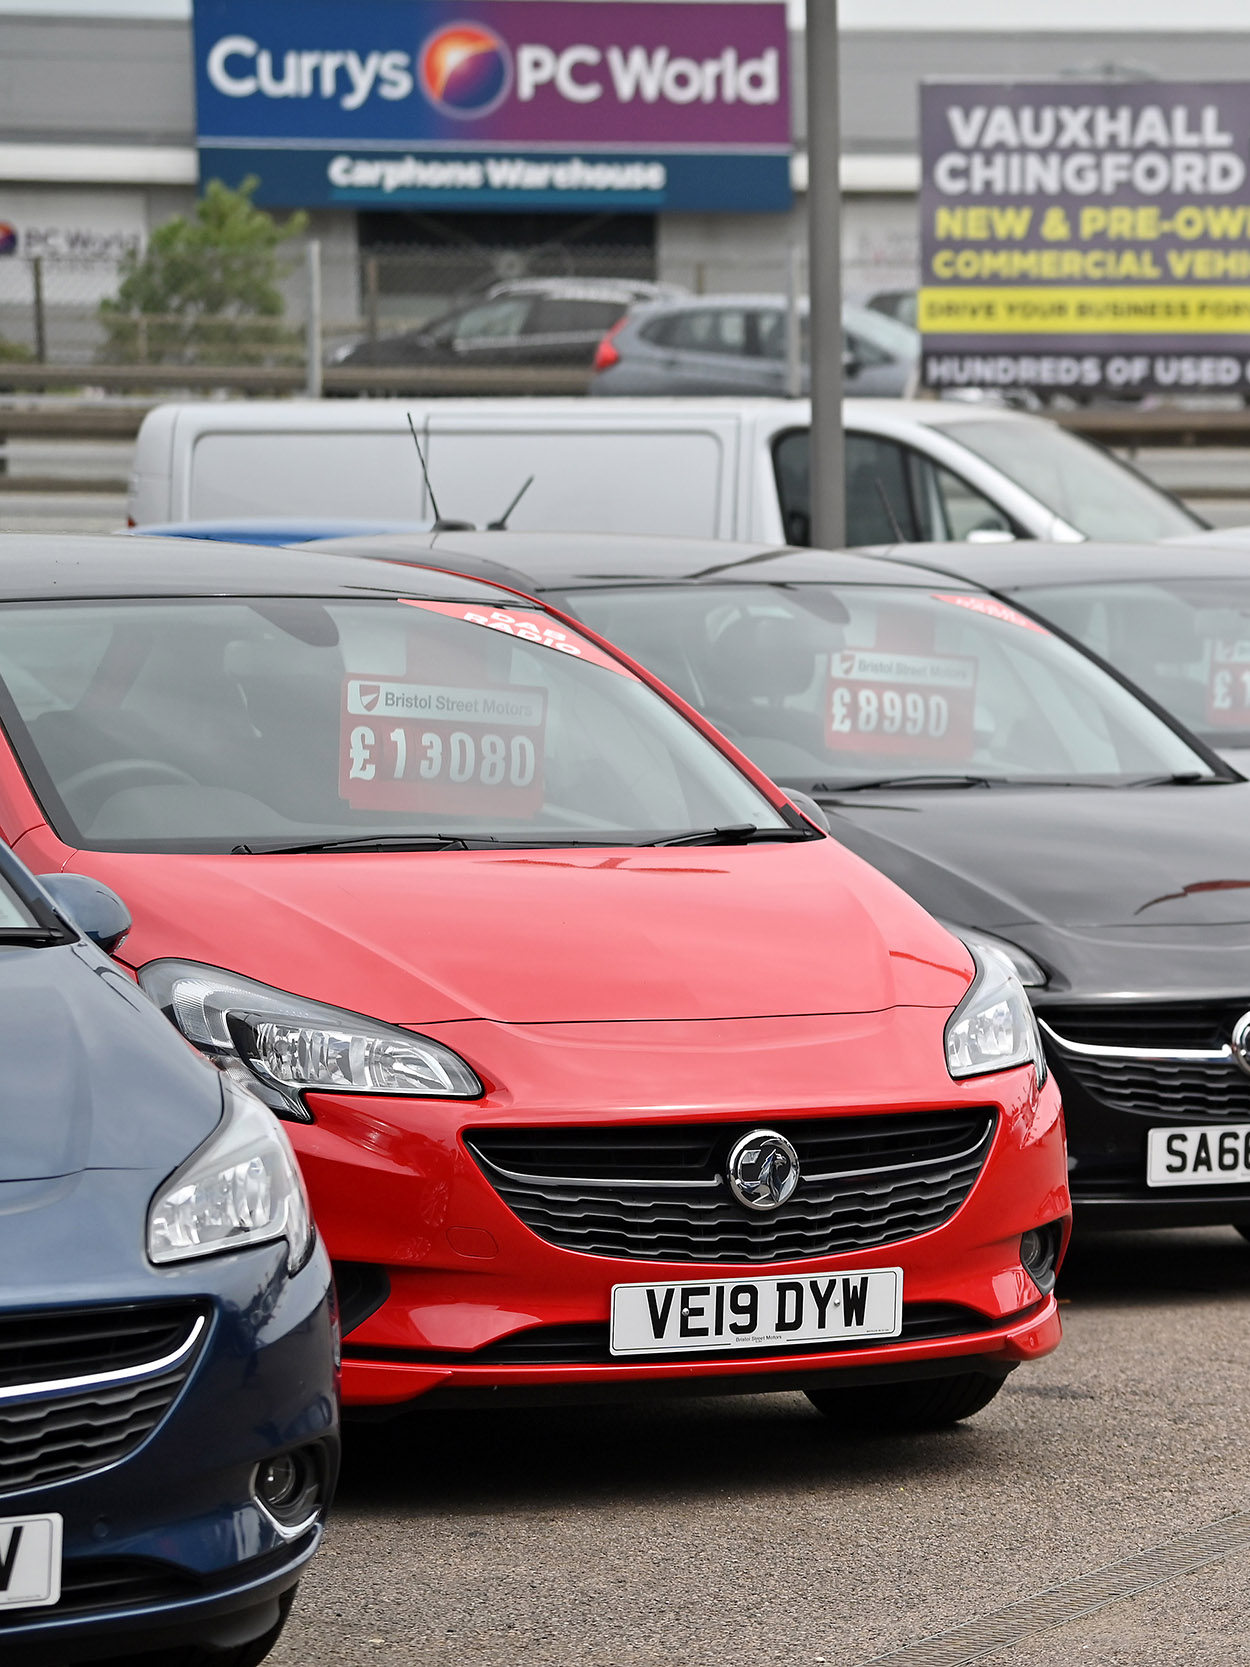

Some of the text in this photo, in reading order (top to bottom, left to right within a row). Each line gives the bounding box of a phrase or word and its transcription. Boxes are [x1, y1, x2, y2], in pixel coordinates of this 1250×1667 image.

[206, 34, 780, 111] Currys PC World
[945, 104, 1235, 149] VAUXHALL
[326, 154, 667, 194] Carphone Warehouse
[932, 152, 1247, 196] CHINGFORD
[934, 206, 1034, 241] NEW
[1040, 206, 1071, 241] &
[931, 250, 1162, 279] COMMERCIAL
[925, 299, 997, 321] DRIVE
[1005, 299, 1070, 320] YOUR
[1077, 298, 1191, 319] BUSINESS
[926, 357, 1100, 386] HUNDREDS
[1106, 356, 1150, 386] OF
[1155, 356, 1240, 386] USED
[464, 612, 581, 655] RADIO
[490, 612, 566, 641] DAB
[385, 692, 534, 717] Bristol Street Motors
[831, 686, 949, 738] £8990
[349, 726, 535, 787] £13080
[646, 1276, 869, 1339] VE19 DYW
